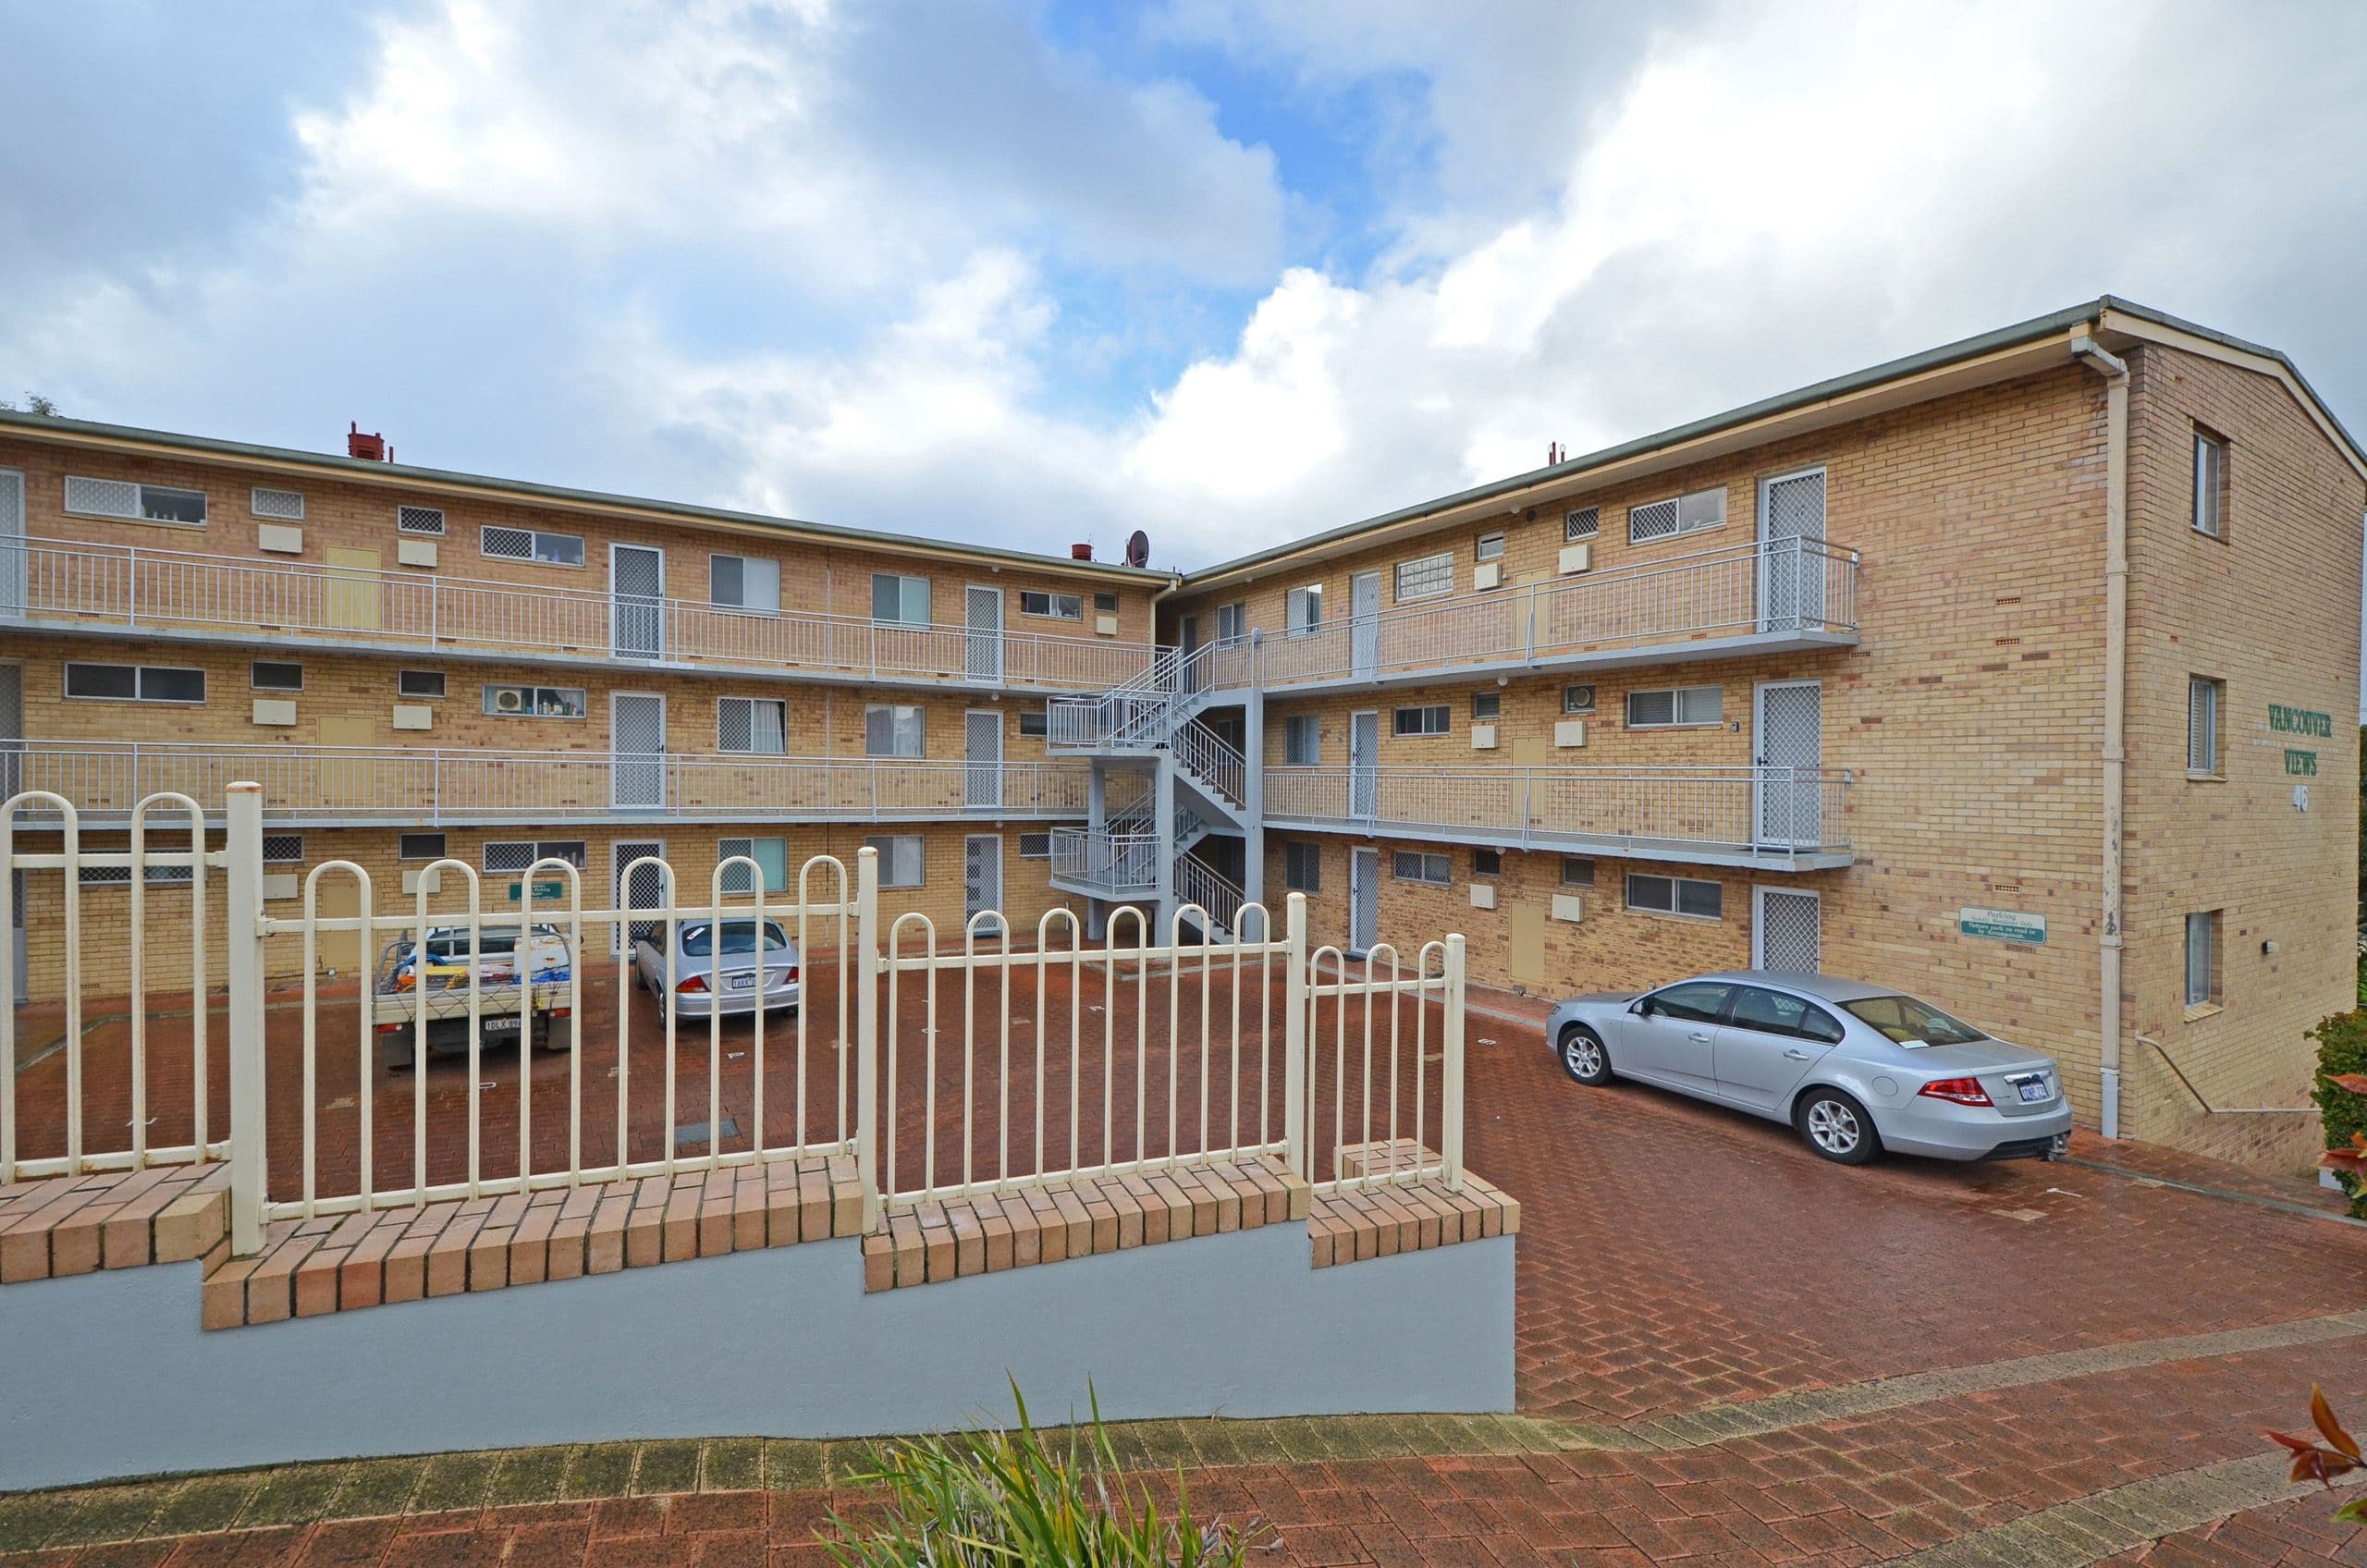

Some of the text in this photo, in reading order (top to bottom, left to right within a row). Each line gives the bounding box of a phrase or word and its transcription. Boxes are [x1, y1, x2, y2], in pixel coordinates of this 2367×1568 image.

[2268, 704, 2332, 738] VANCOUVER
[2284, 749, 2317, 777] VIEWS
[1987, 911, 2017, 921] Parking
